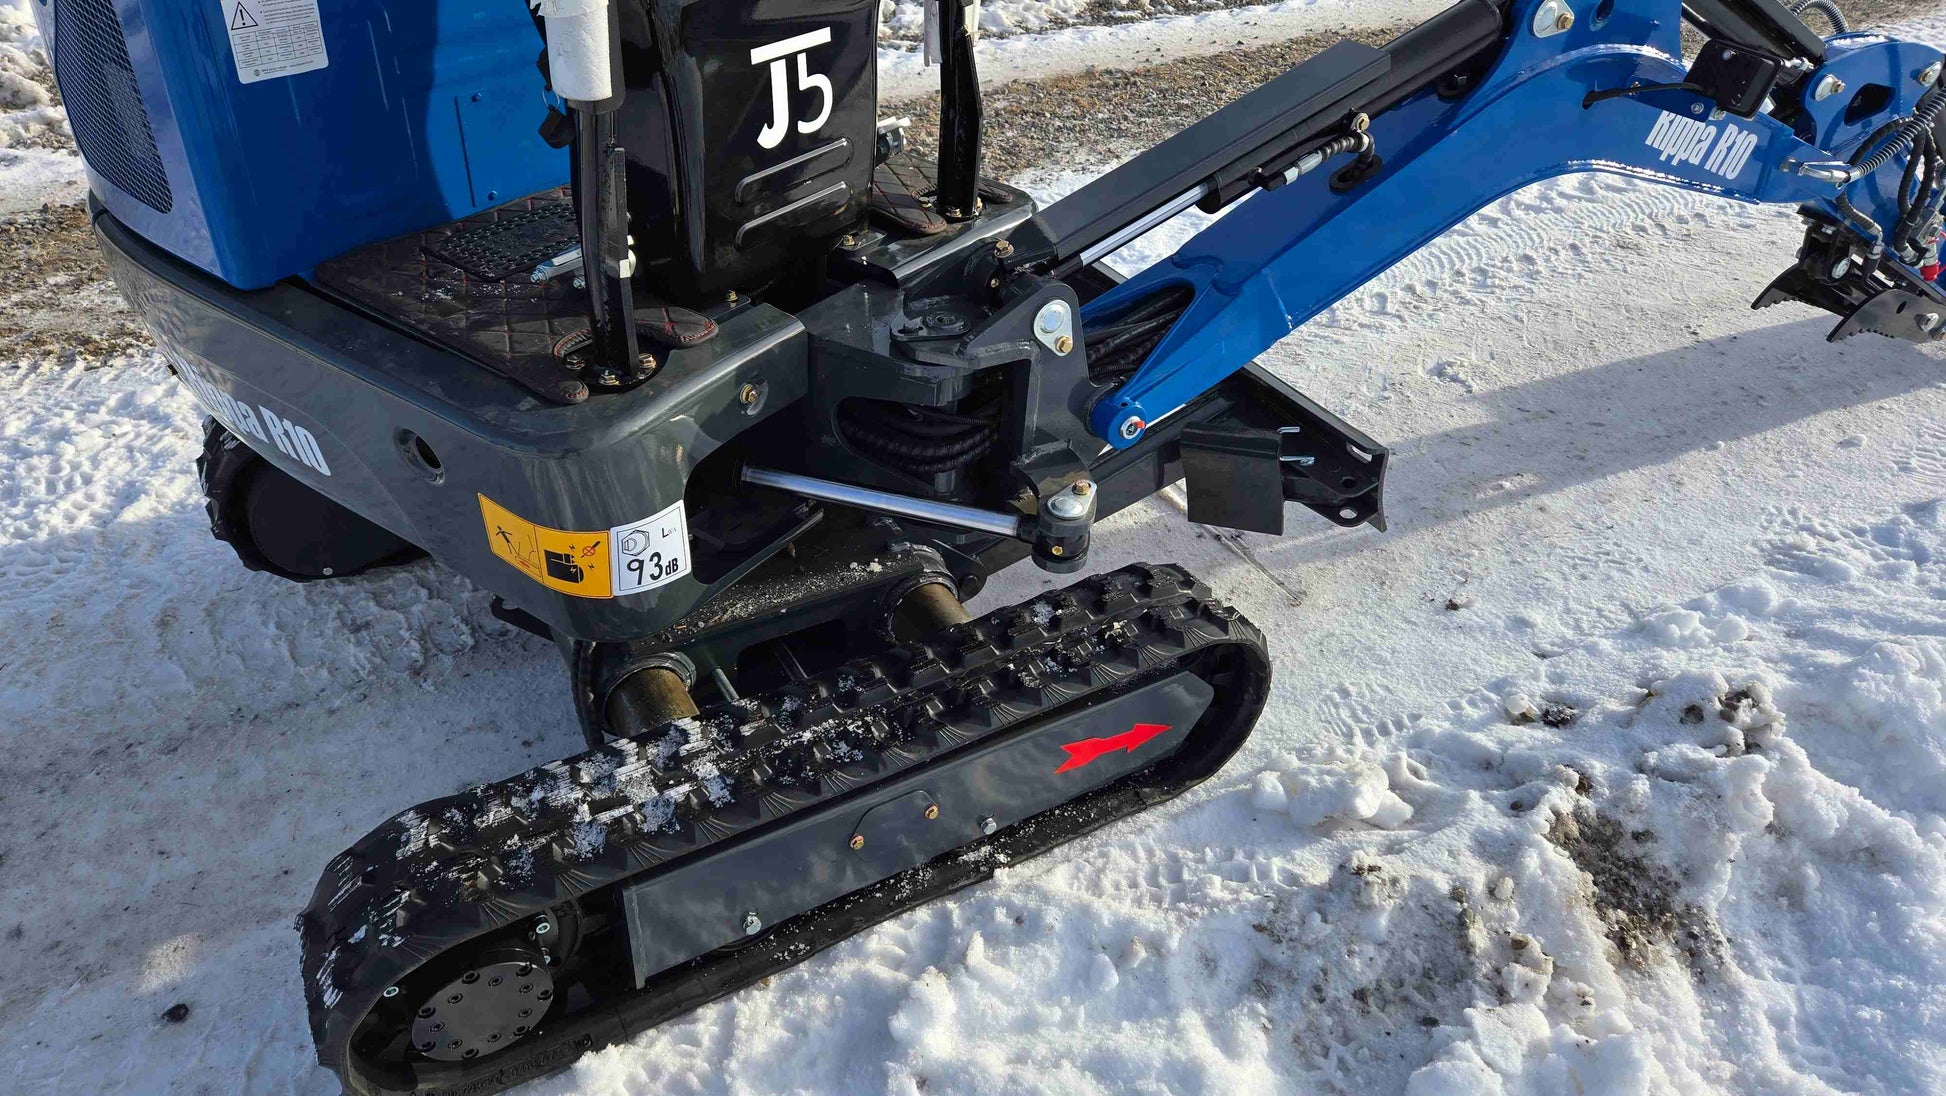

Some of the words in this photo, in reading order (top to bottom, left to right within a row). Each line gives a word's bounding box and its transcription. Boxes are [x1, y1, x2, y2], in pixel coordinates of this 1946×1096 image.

[1645, 109, 1717, 166] Rippa
[1704, 123, 1758, 180] R10
[258, 405, 331, 476] R10
